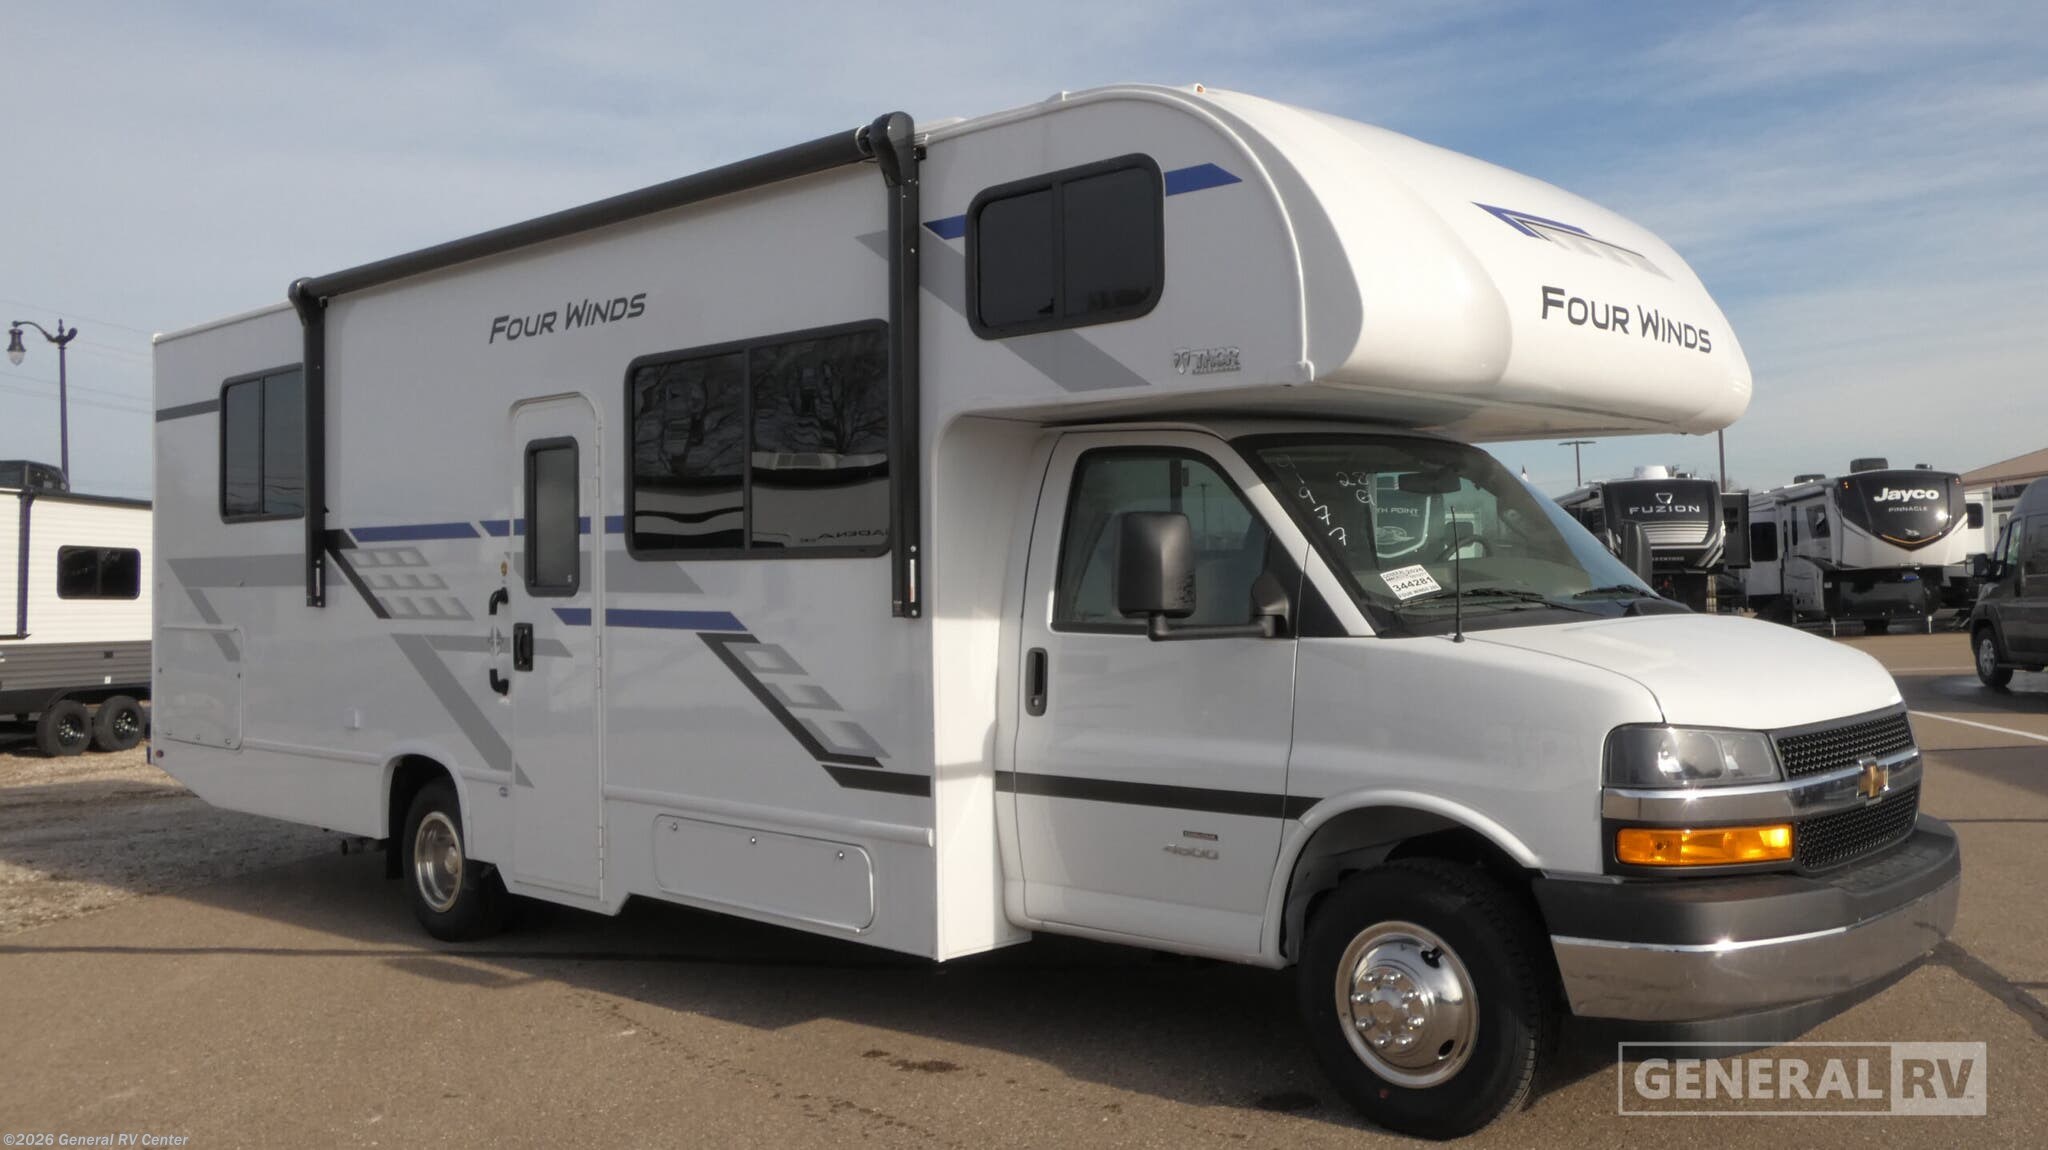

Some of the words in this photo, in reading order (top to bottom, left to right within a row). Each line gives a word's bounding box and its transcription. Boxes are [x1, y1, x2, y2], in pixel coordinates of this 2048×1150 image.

[488, 310, 558, 344] FOUR
[564, 292, 647, 331] WINDS
[1541, 285, 1630, 335] FOUR
[1637, 304, 1712, 354] WINDS
[1873, 487, 1940, 503] Jayco
[1629, 504, 1701, 515] FUZION
[1888, 505, 1928, 513] PINNACLE
[1392, 576, 1434, 592] 344281
